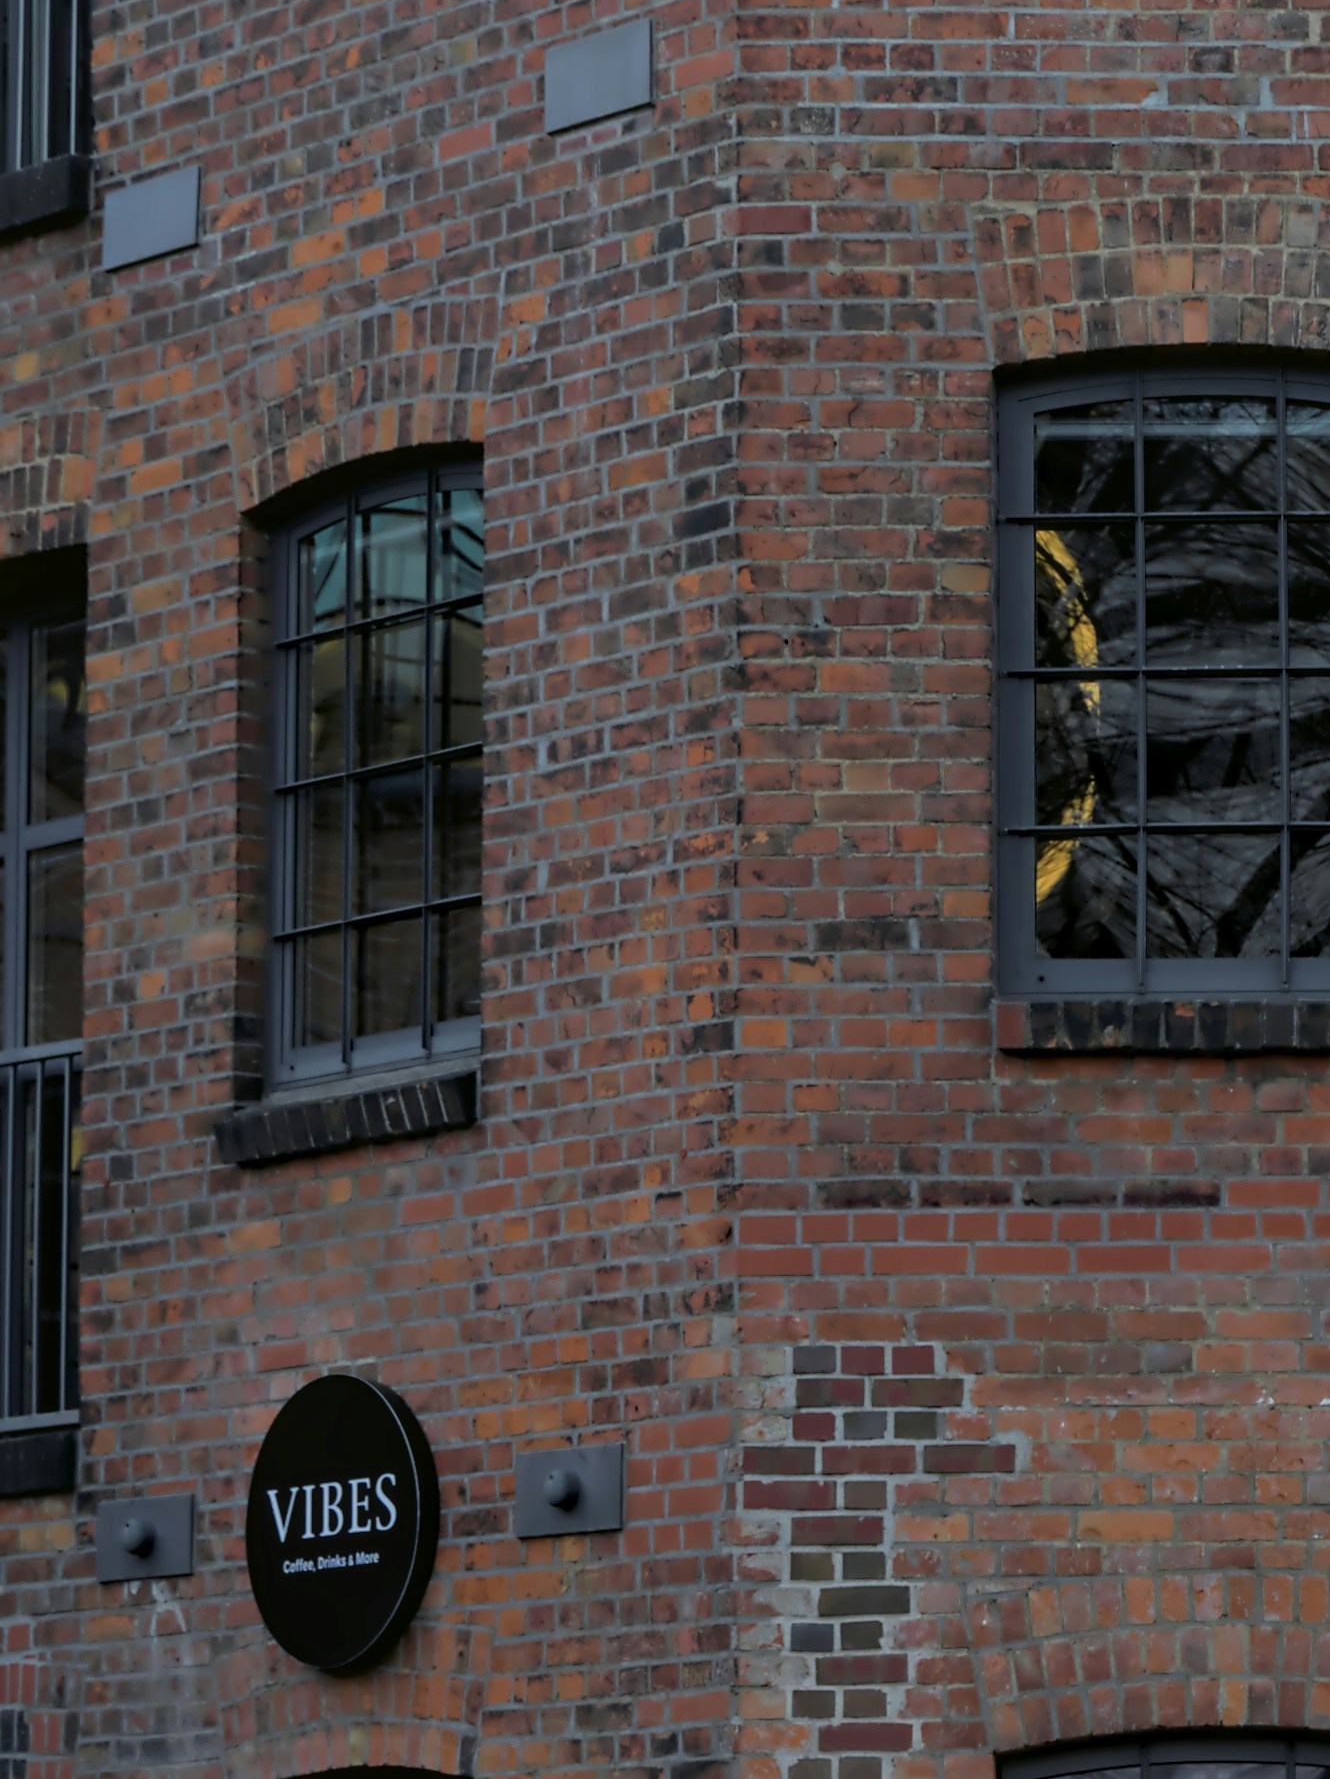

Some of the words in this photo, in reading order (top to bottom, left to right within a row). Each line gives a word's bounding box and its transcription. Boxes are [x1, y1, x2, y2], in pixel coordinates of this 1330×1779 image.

[266, 1472, 397, 1543] VIBES
[283, 1558, 317, 1574] Coffee,
[318, 1554, 347, 1570] Drinks
[355, 1551, 380, 1565] More
